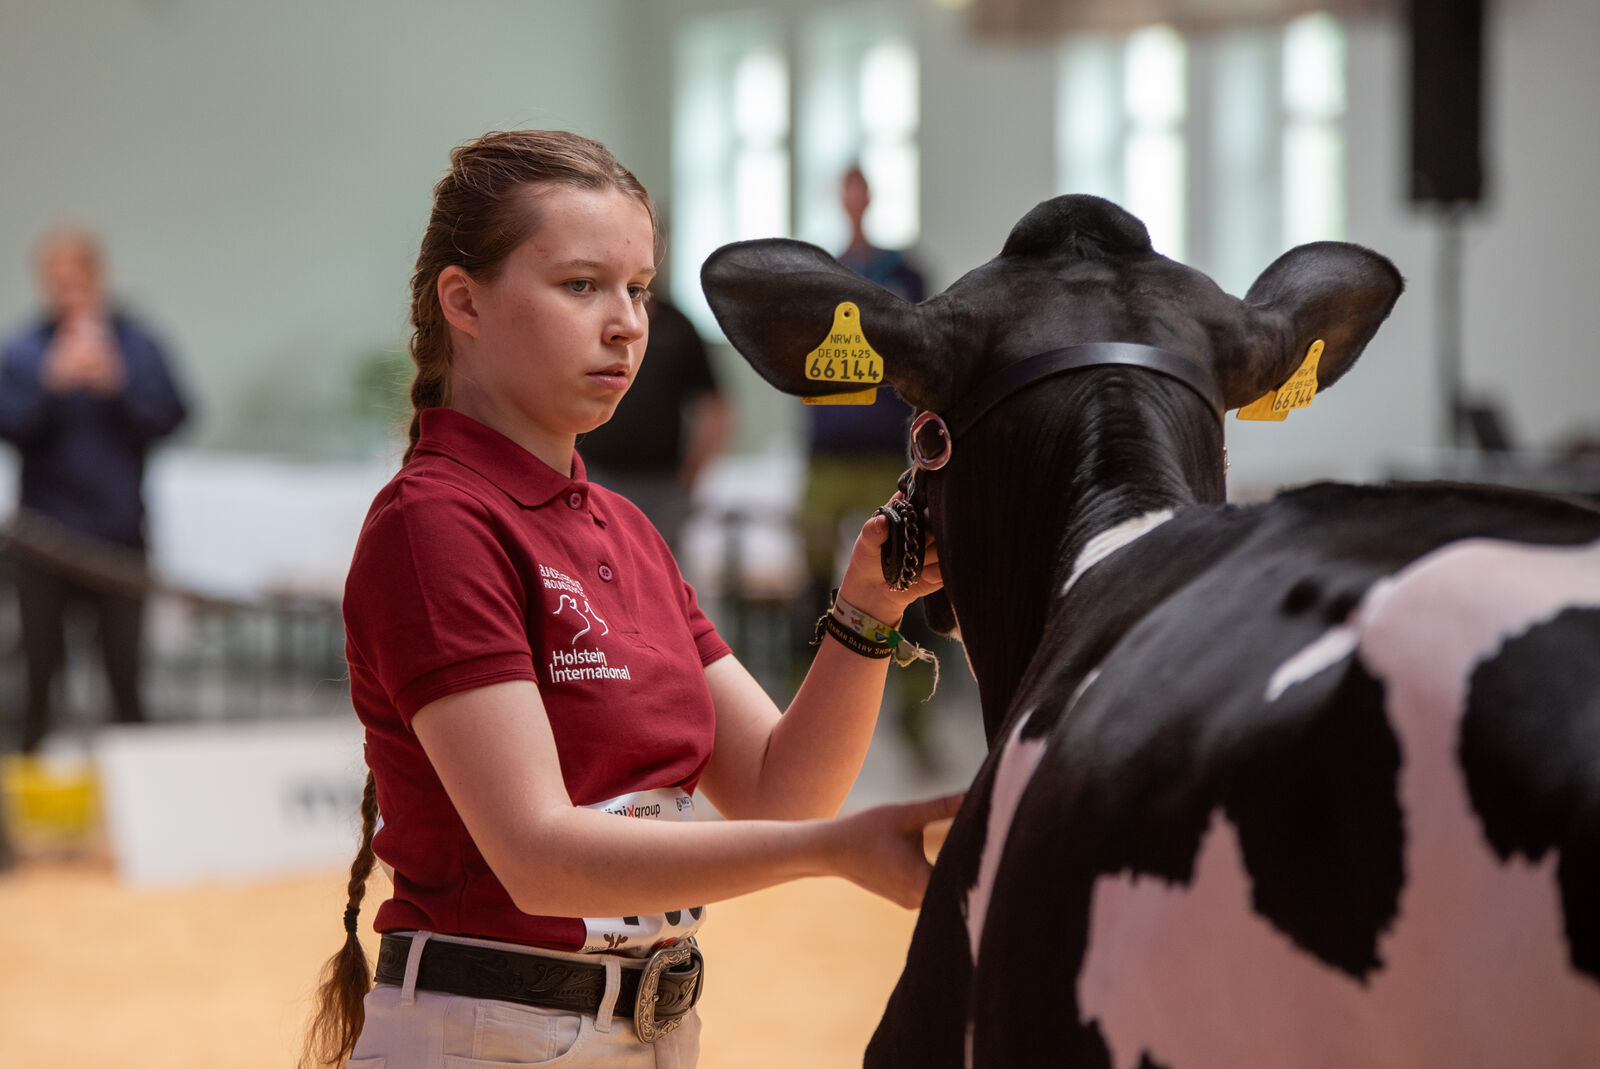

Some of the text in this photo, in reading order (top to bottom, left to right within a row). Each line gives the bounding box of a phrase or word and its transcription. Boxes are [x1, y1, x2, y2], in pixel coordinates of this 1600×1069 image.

[830, 334, 852, 344] NRW
[818, 348, 871, 359] DE 05 425
[809, 358, 880, 380] 66144
[1274, 387, 1313, 411] 66144
[552, 647, 608, 667] Holstein
[549, 665, 631, 683] International
